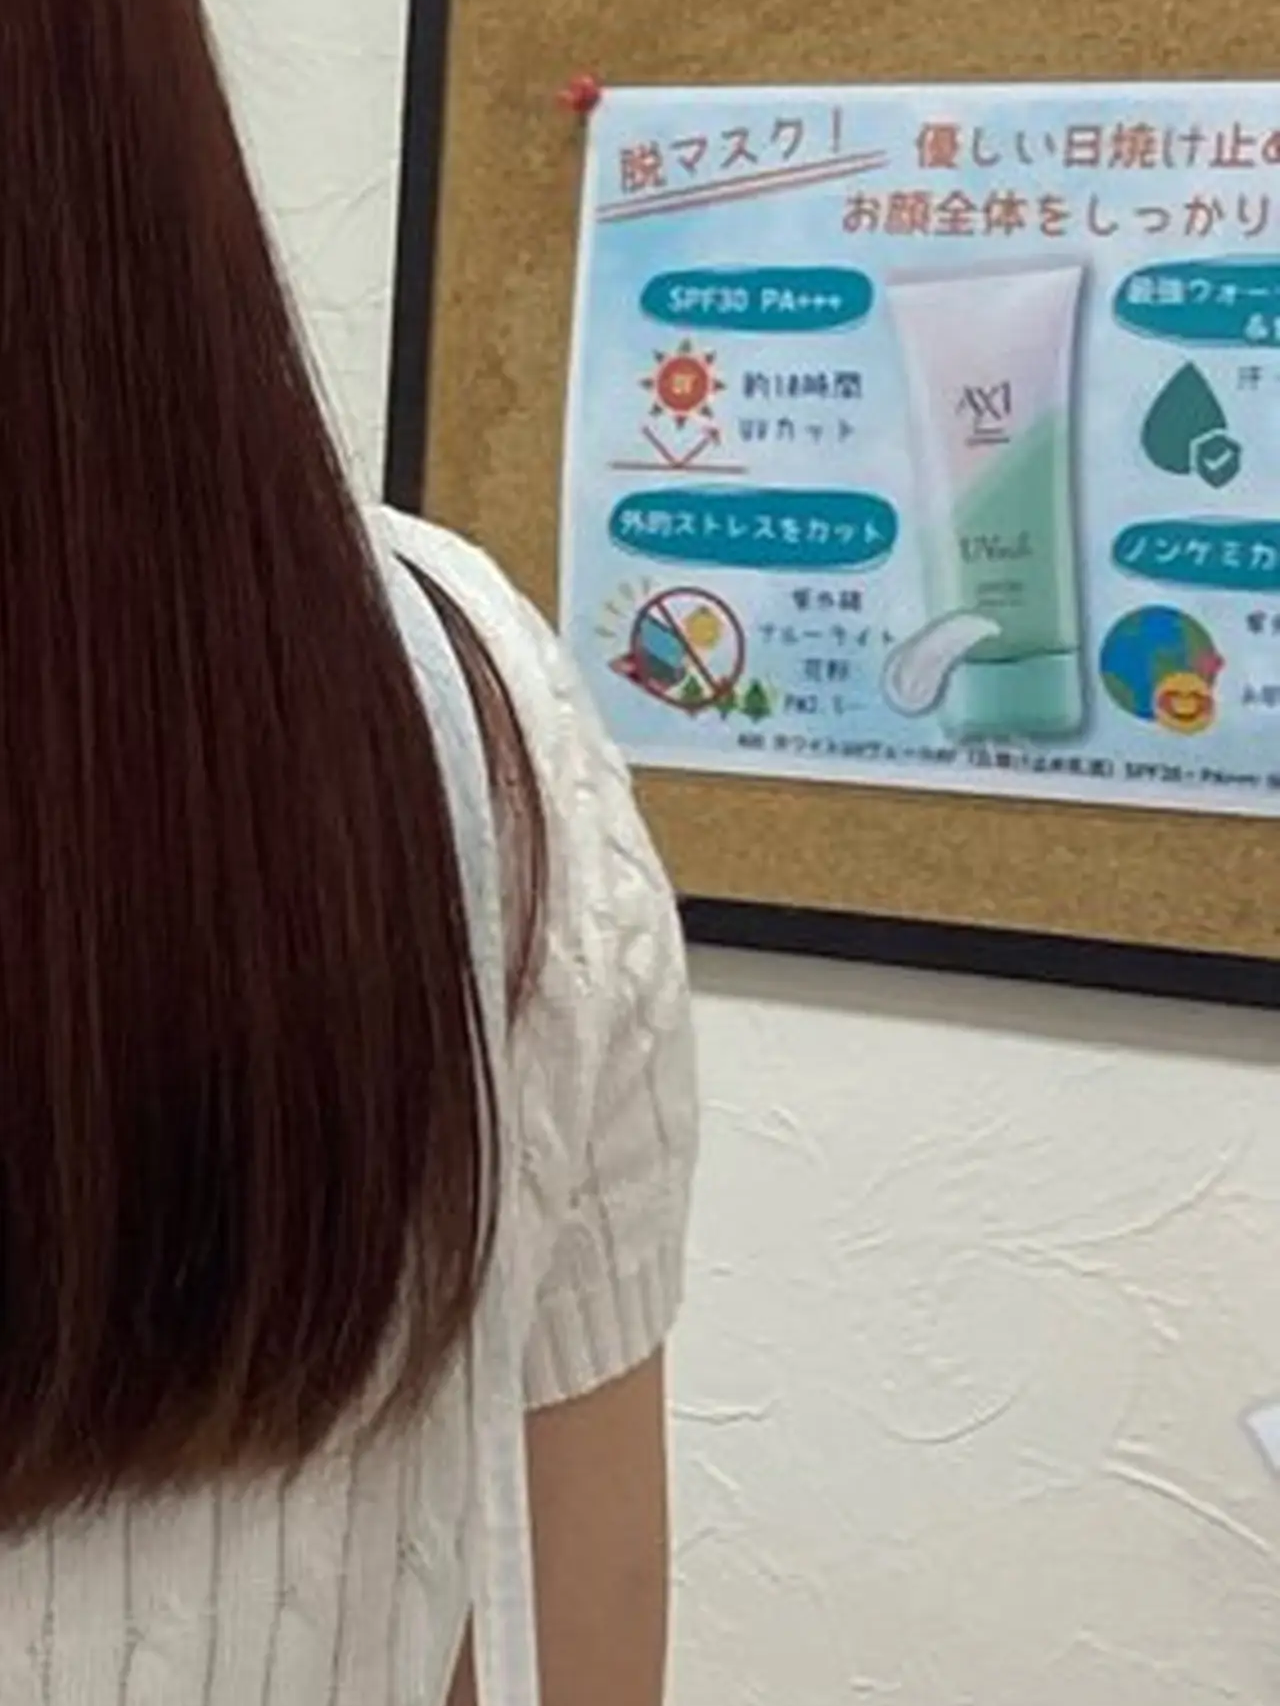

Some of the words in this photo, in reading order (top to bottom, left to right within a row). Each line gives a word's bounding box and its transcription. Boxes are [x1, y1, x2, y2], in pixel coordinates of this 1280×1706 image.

[841, 191, 1270, 239] お顔全体をしっかり
